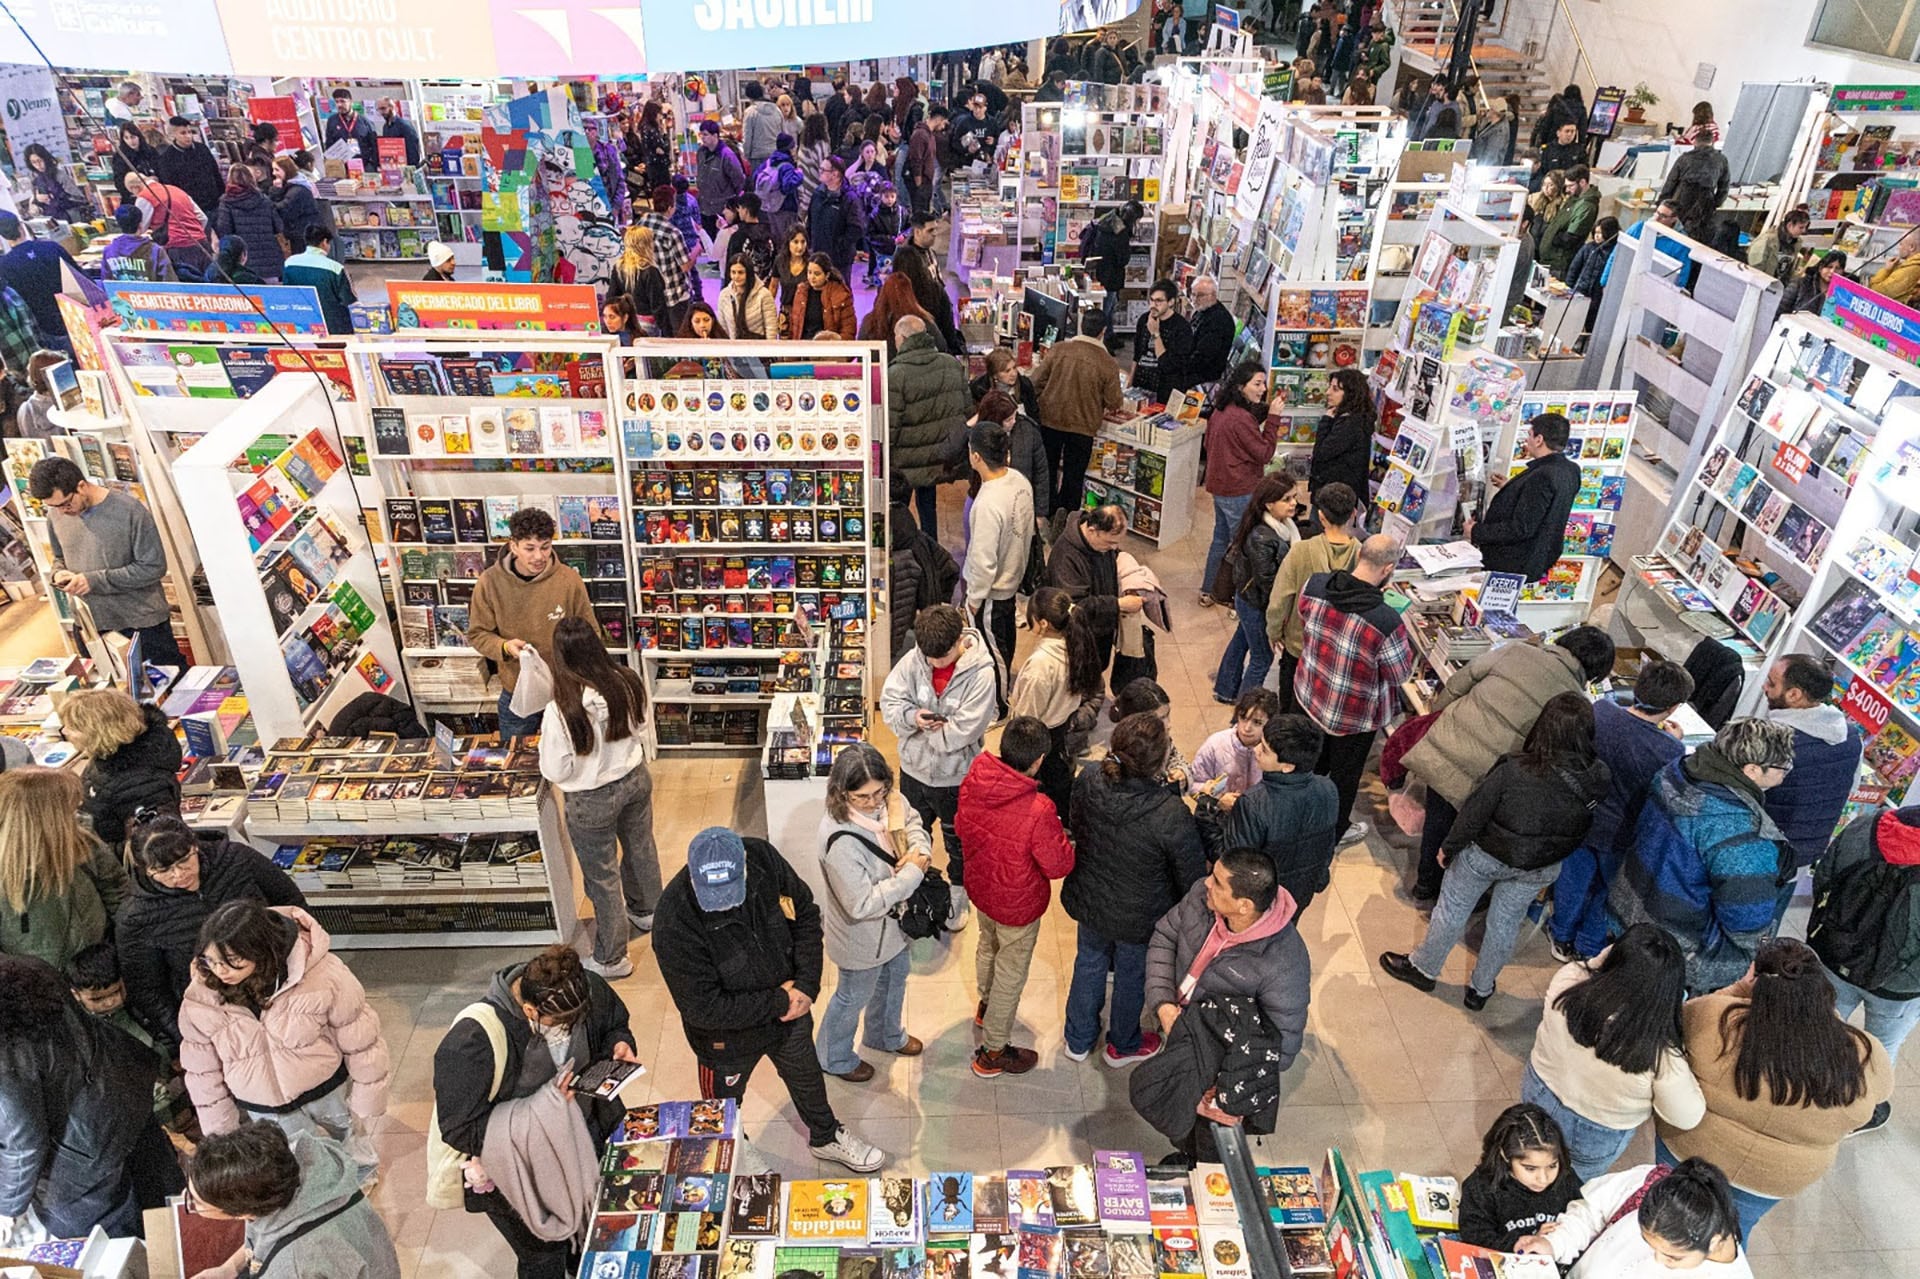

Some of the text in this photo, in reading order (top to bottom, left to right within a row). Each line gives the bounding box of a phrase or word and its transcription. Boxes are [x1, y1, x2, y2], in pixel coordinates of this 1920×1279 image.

[83, 15, 167, 36] Cultura
[271, 25, 443, 62] CENTRO CULT.
[129, 293, 195, 311] REMITENTE
[195, 295, 255, 313] PATAGONIA
[400, 293, 486, 312] SUPERMERCADO
[487, 295, 508, 311] DEL
[509, 296, 540, 313] LIBRO
[1850, 296, 1905, 333] PUEBLO LIBROS
[1490, 576, 1519, 590] OFERTA
[1847, 682, 1889, 726] $4000
[698, 860, 738, 875] ARGENTINA
[1103, 1196, 1145, 1208] BAYER
[1104, 1207, 1146, 1217] OSVALDO
[791, 1219, 863, 1235] mafalda
